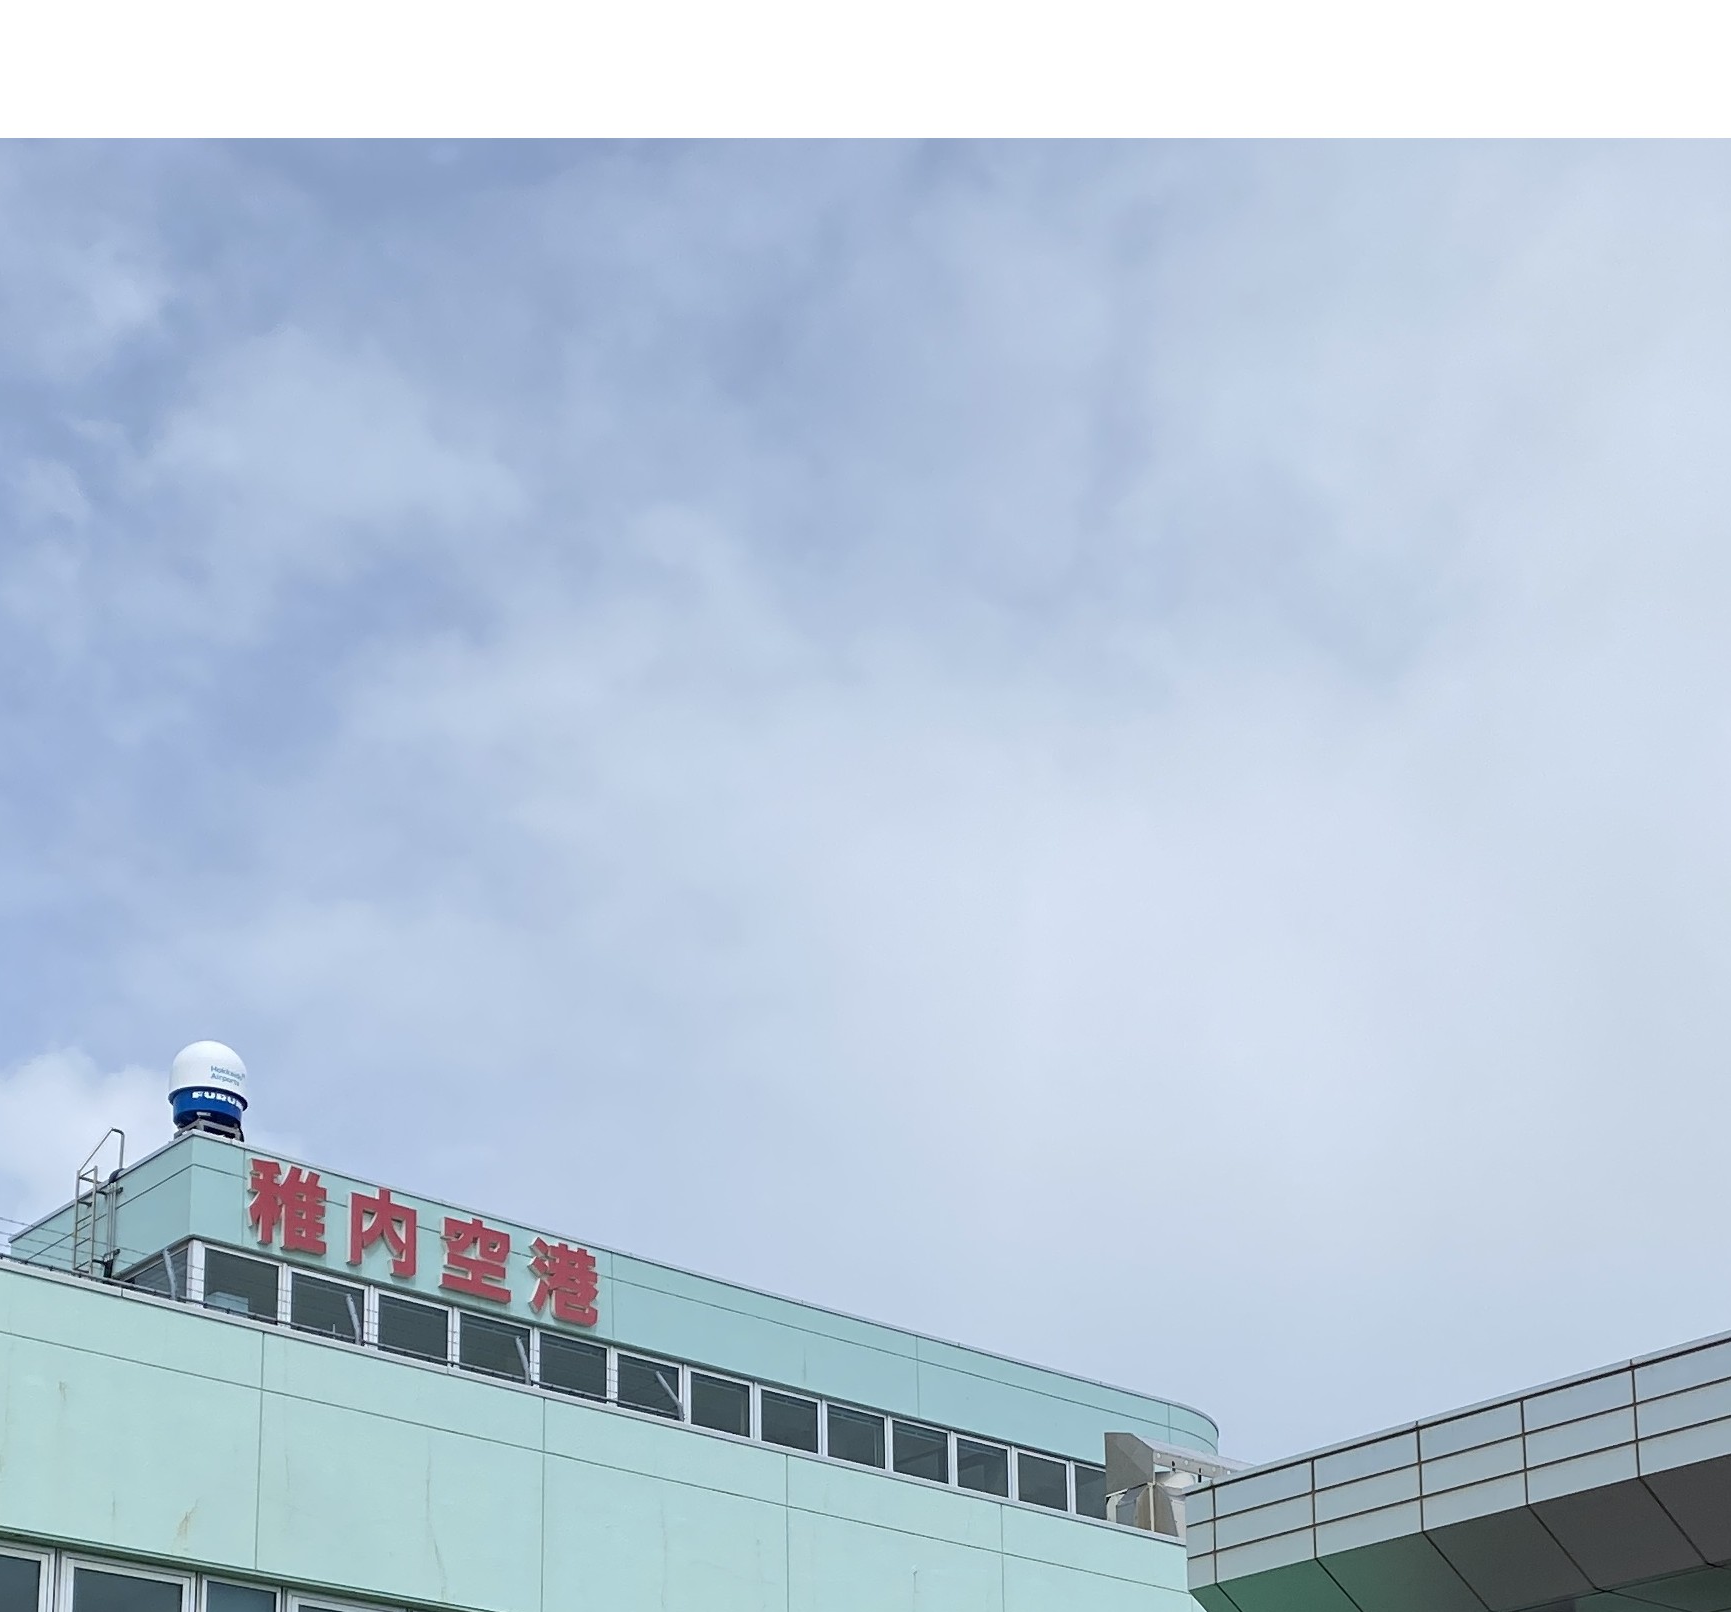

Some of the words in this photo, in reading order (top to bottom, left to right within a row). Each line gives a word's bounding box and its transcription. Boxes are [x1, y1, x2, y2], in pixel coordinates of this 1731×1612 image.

[210, 1073, 240, 1087] Airports
[248, 1157, 599, 1328] 稚内空港
